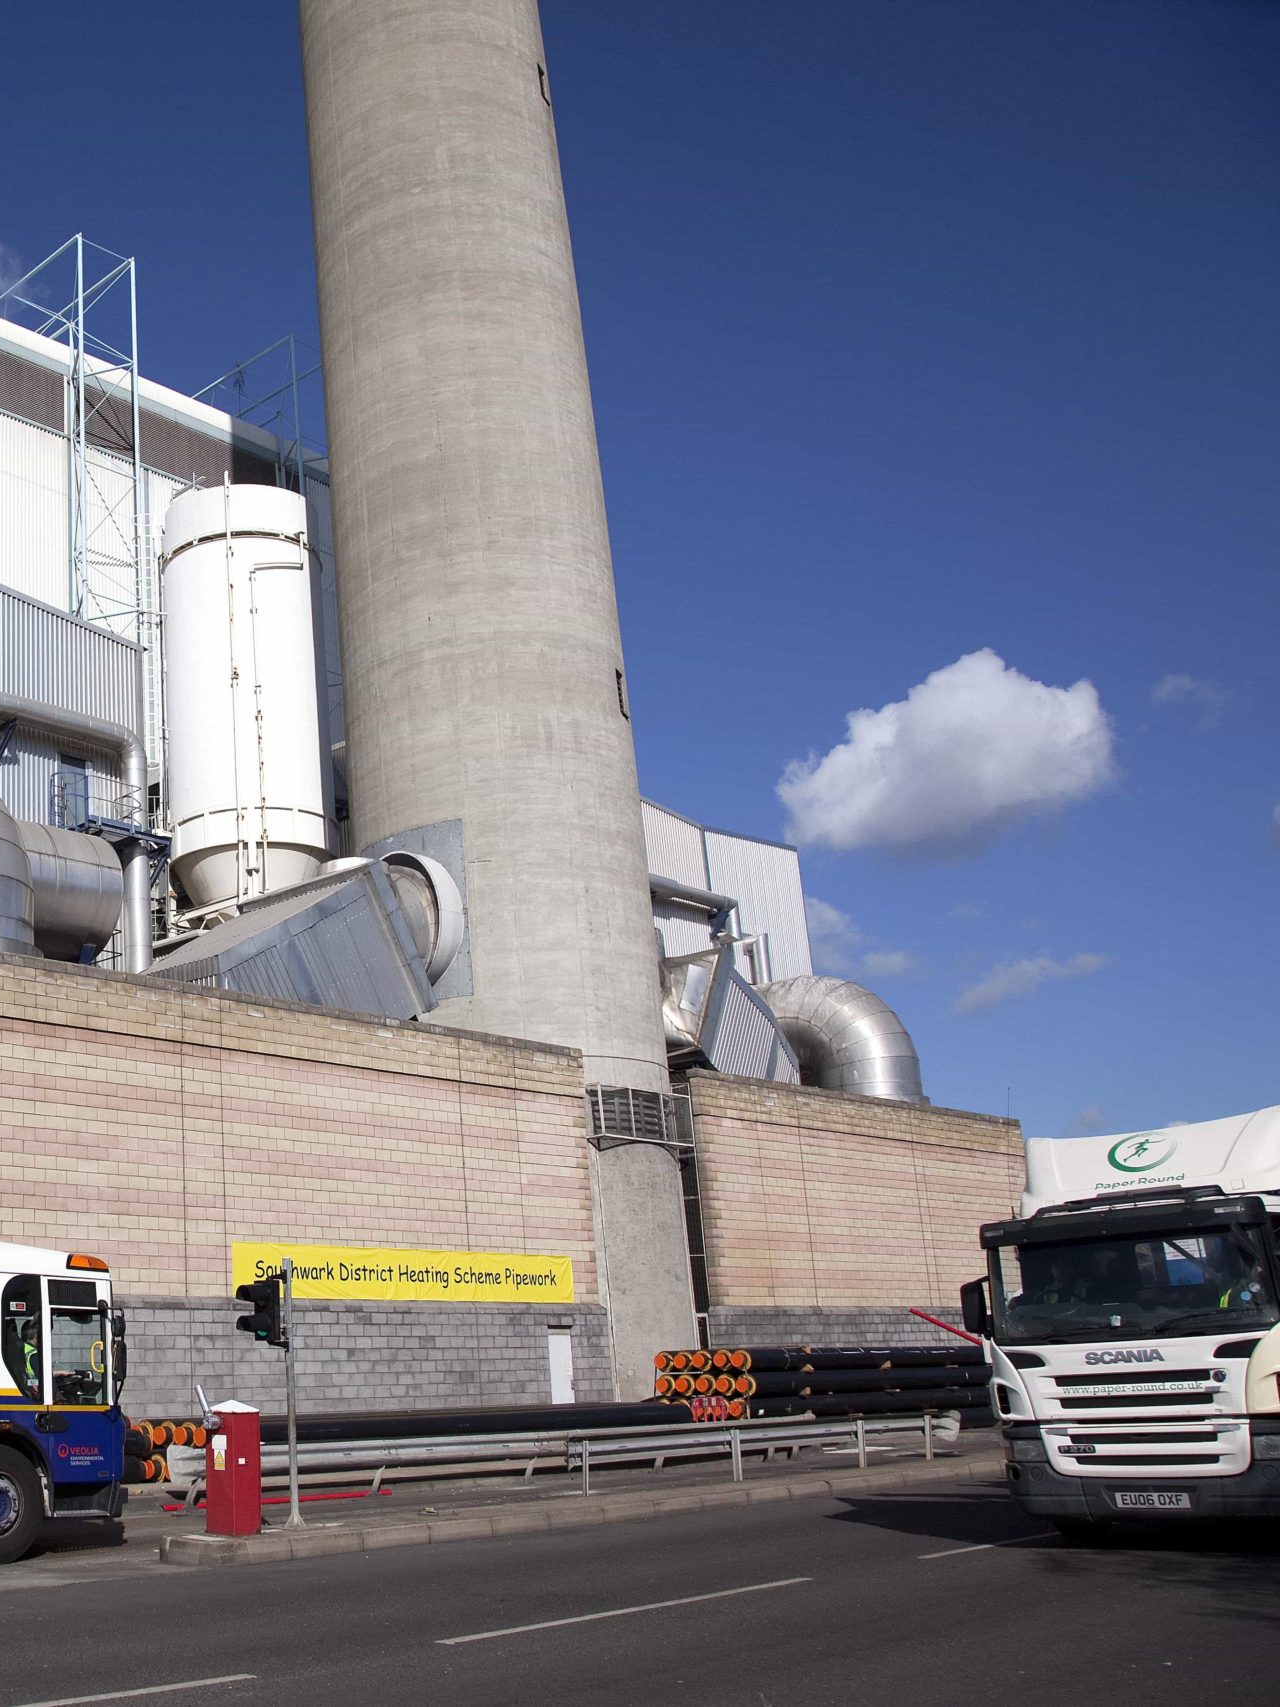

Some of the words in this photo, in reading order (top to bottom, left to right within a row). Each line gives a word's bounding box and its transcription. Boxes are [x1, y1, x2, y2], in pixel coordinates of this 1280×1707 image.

[1137, 1173, 1185, 1184] Round
[255, 1260, 335, 1280] Souhwark
[339, 1263, 394, 1282] District
[398, 1265, 450, 1288] Heating
[453, 1267, 502, 1285] Scheme
[505, 1267, 557, 1290] Pipework
[1084, 1348, 1165, 1366] SCANIA
[1062, 1380, 1203, 1396] www.paper-round.co.uk
[70, 1447, 99, 1455] VEOLIA
[1121, 1494, 1155, 1506] EU06
[1159, 1494, 1182, 1506] OXF
